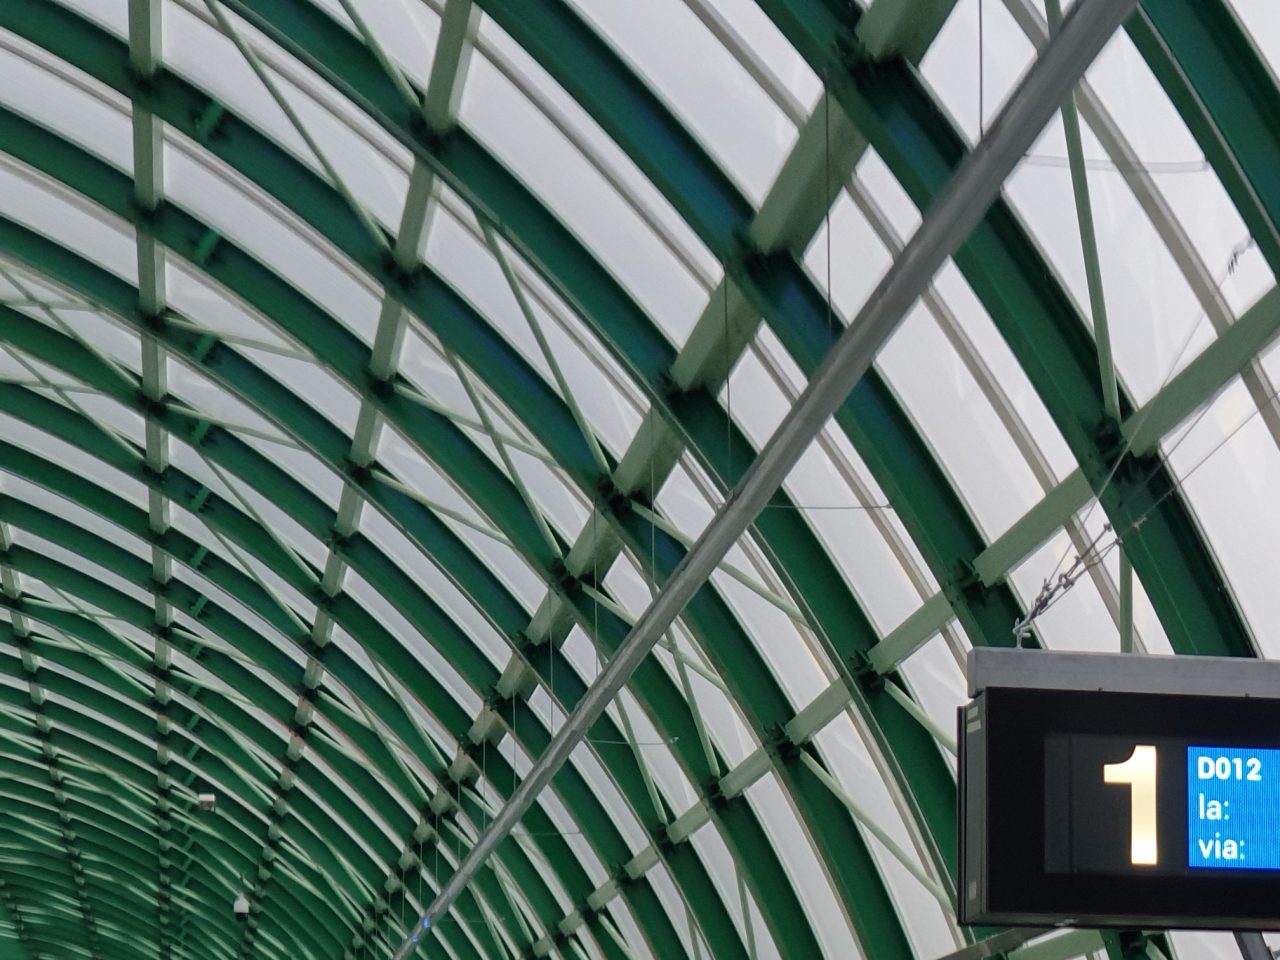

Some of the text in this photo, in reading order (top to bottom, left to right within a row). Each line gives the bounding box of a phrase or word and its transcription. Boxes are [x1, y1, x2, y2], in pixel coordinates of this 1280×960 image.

[1197, 756, 1262, 781] D012
[1104, 745, 1157, 865] 1
[1199, 793, 1230, 820] la:
[1199, 832, 1245, 860] via:
